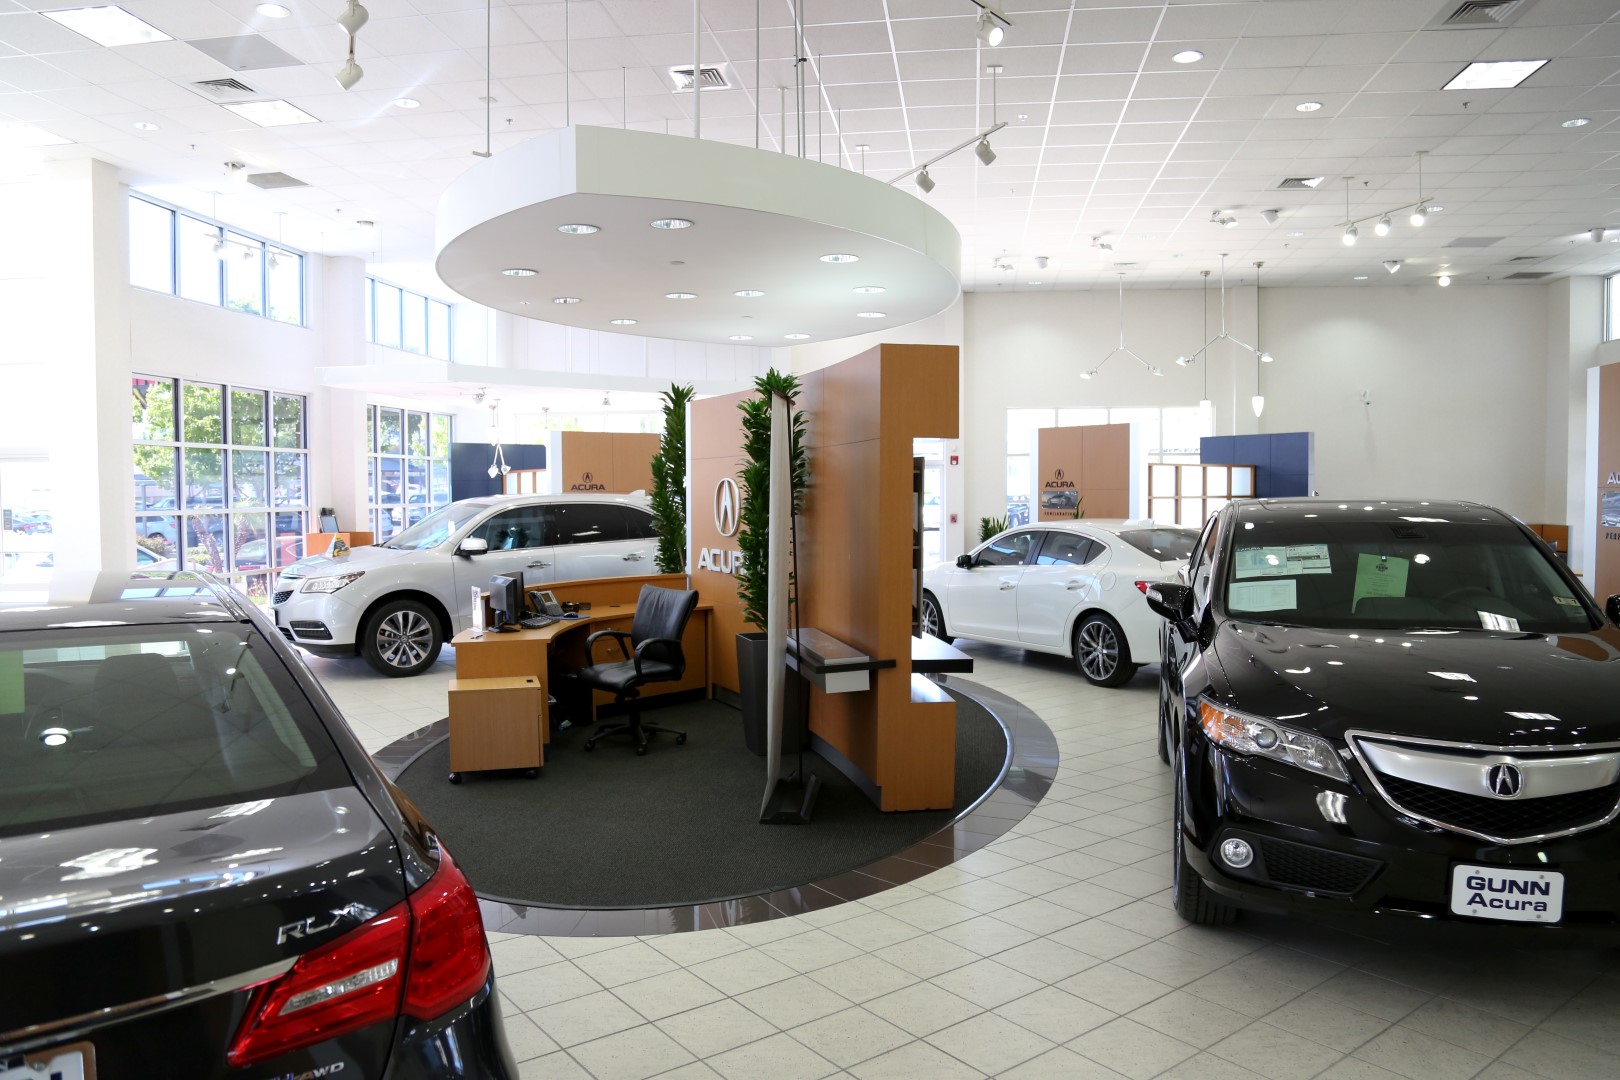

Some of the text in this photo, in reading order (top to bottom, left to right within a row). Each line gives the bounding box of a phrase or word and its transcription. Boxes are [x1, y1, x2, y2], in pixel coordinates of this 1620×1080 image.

[697, 547, 749, 576] ACUR
[1466, 875, 1551, 896] GUNN
[1466, 892, 1548, 912] Acura
